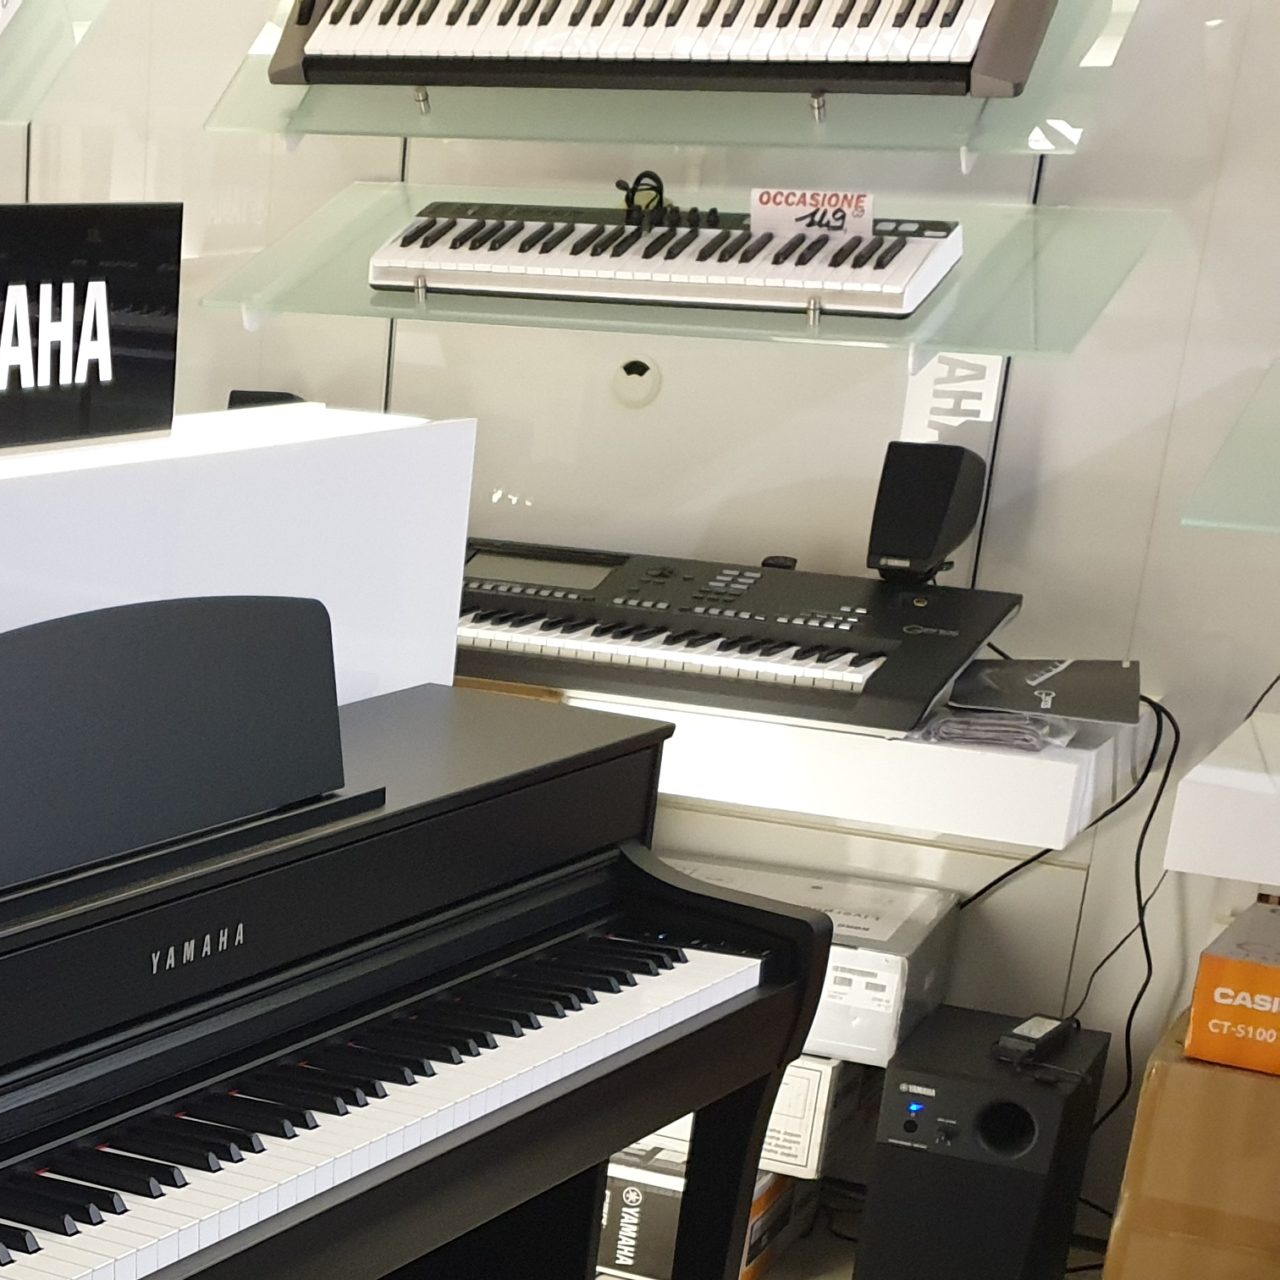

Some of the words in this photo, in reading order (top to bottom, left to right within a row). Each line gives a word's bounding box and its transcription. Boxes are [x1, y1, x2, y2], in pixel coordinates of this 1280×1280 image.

[758, 190, 867, 209] OCCASIONE
[150, 922, 245, 975] YAMAHA
[1214, 987, 1280, 1013] CASI
[1208, 1018, 1277, 1043] CT-S100
[615, 1207, 641, 1266] YAMAHA
